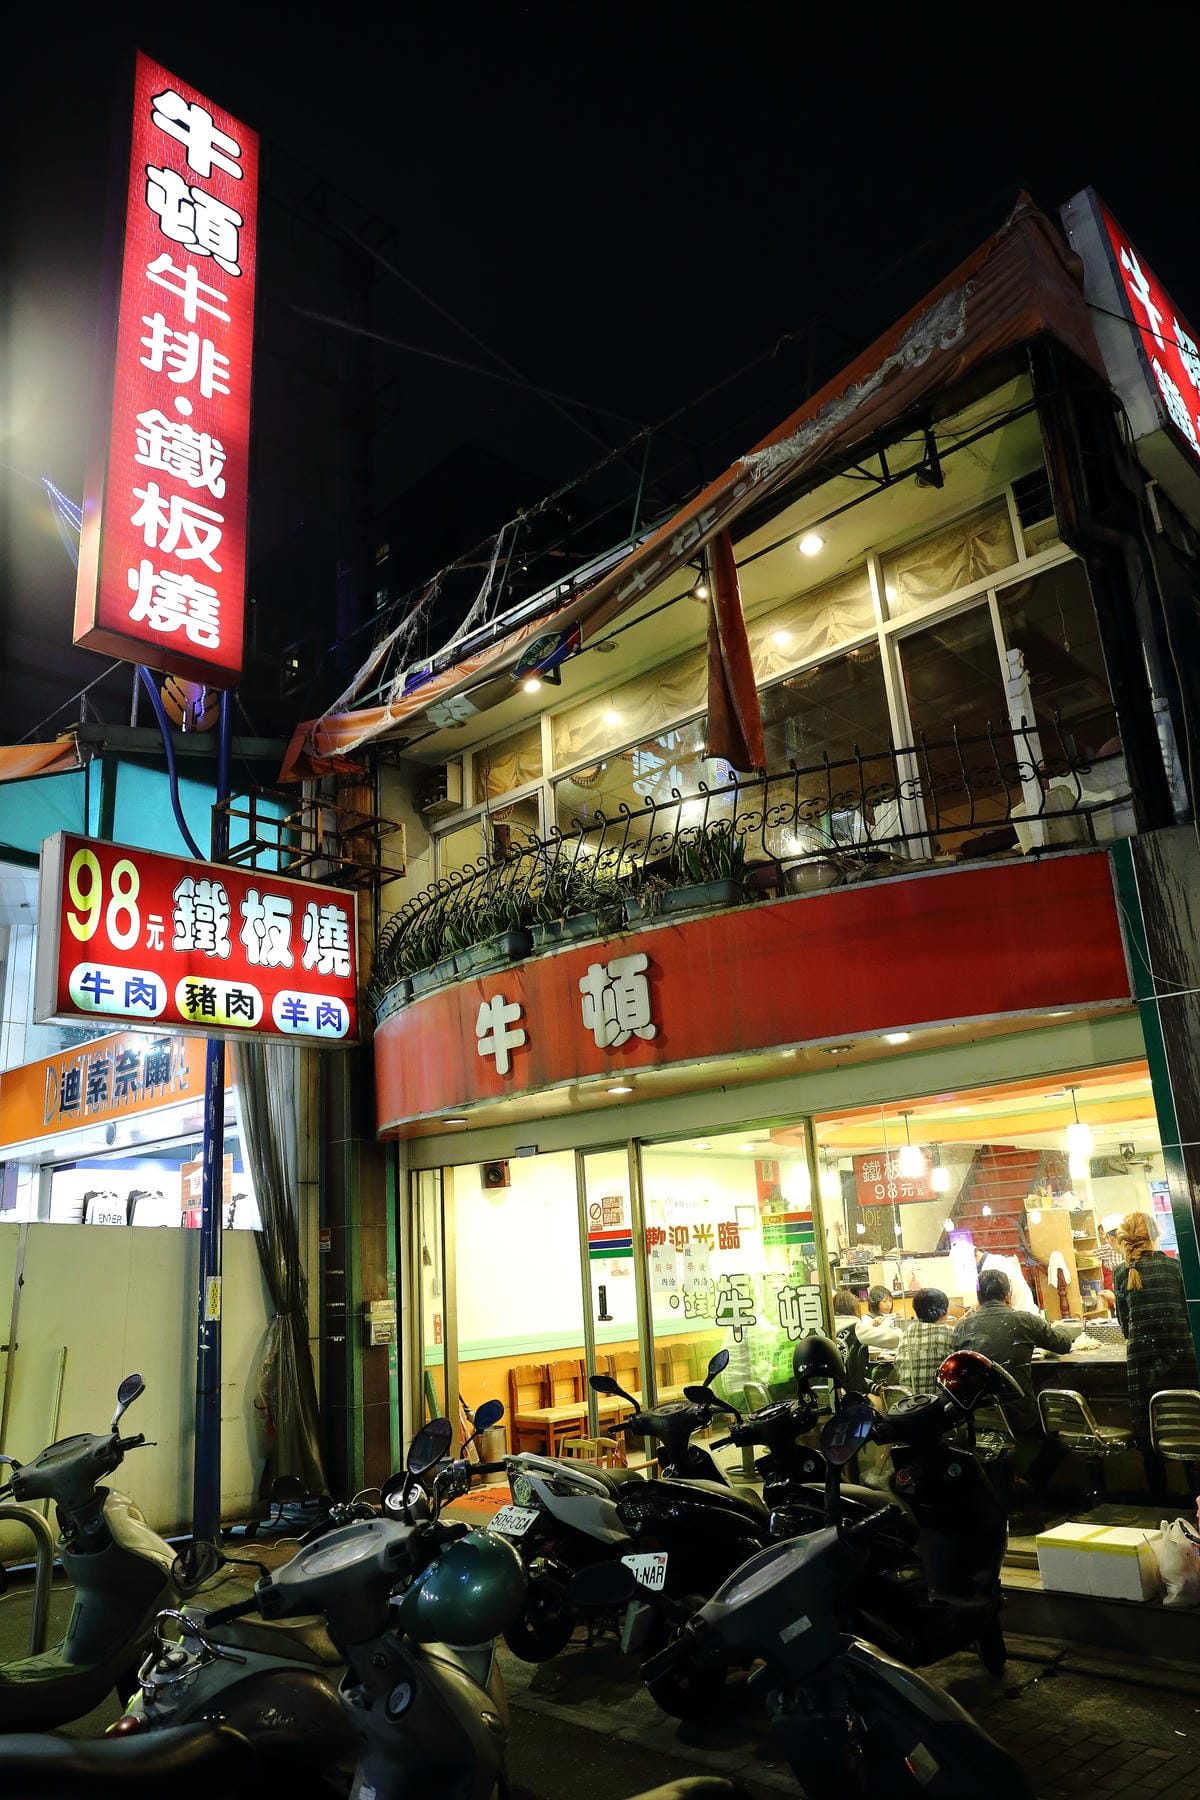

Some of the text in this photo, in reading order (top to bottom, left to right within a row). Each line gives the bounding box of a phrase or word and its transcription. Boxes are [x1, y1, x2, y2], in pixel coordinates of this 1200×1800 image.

[80, 970, 342, 1032] 牛肉 豬肉 羊肉
[59, 1037, 171, 1112] 迪索奈爾
[645, 1221, 741, 1255] 歡迎光臨
[634, 1565, 665, 1585] 1-NAR
